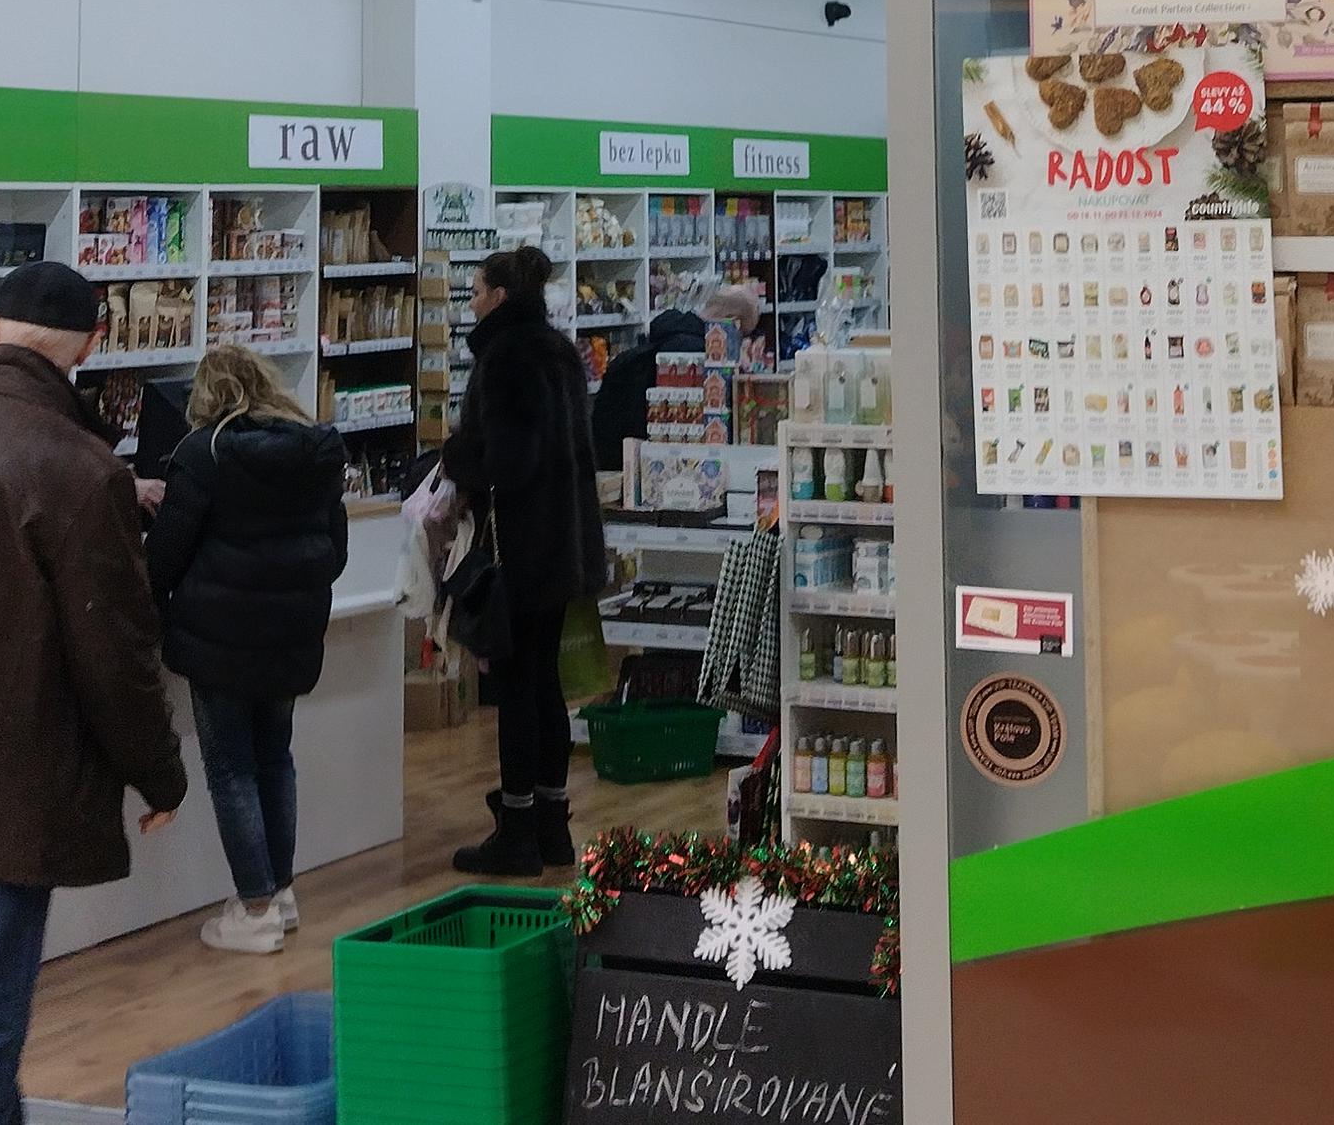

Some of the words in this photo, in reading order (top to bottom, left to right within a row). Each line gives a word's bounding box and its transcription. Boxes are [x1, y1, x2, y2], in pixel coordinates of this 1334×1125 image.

[1200, 97, 1226, 115] 44
[1228, 96, 1247, 115] %
[278, 120, 357, 164] raw
[608, 137, 635, 164] bez
[639, 139, 683, 171] lepku
[744, 144, 802, 175] fitness
[1047, 146, 1180, 192] RADOST
[596, 992, 769, 1053] MANDLE
